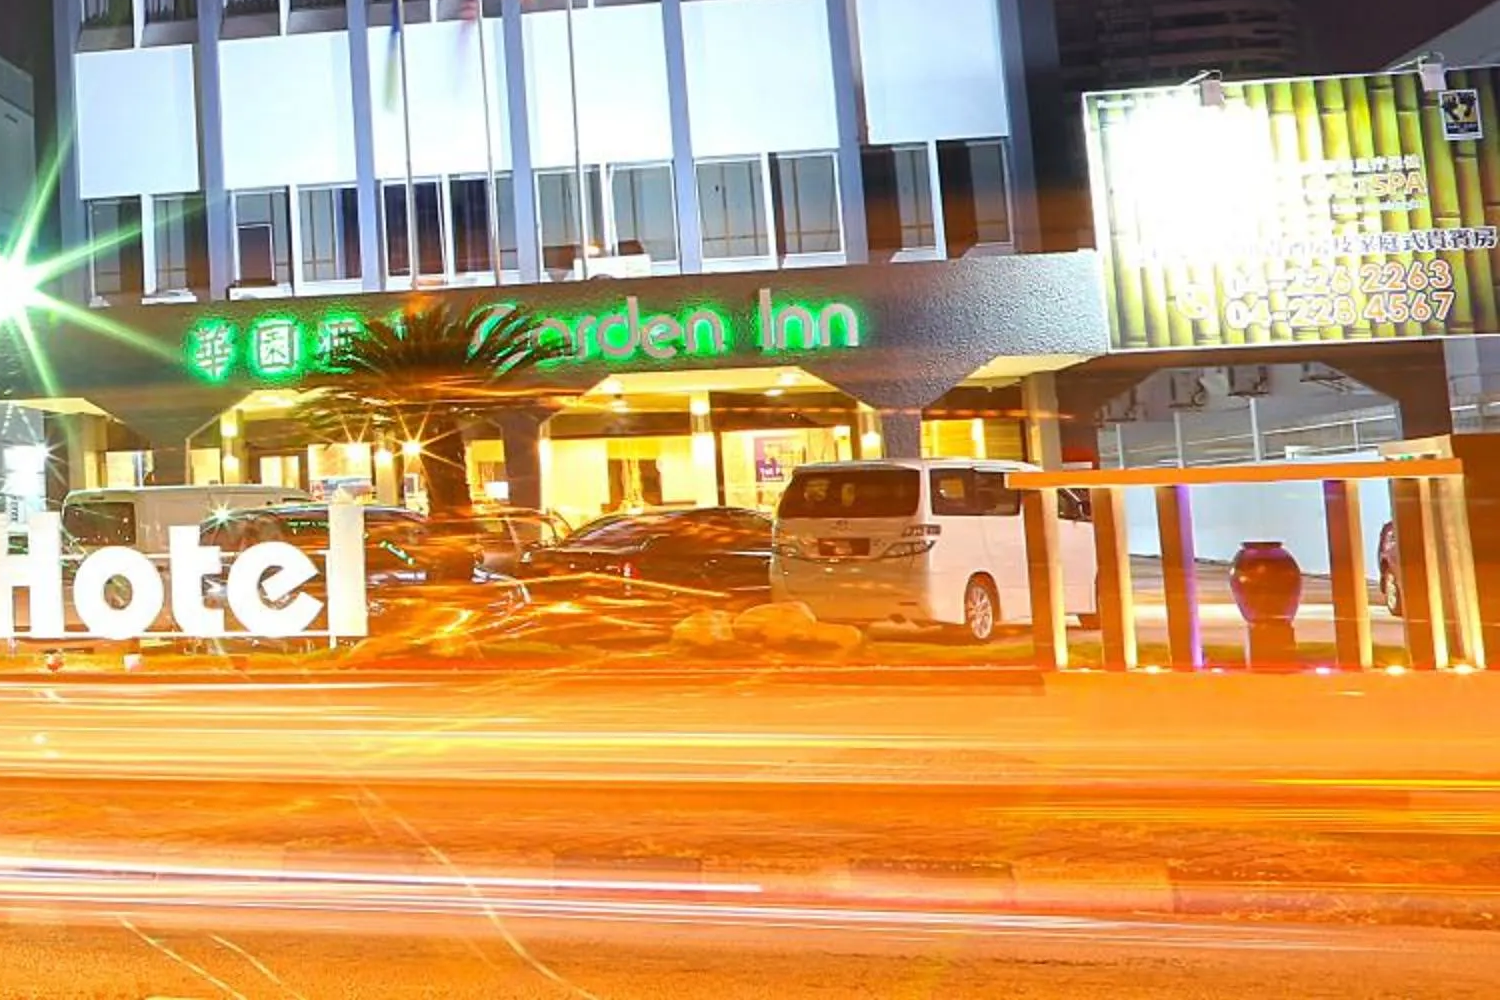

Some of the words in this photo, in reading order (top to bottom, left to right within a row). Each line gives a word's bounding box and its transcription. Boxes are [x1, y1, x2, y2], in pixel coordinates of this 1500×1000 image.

[1360, 259, 1453, 295] 2263
[758, 287, 859, 351] Inn
[1362, 290, 1456, 323] 4567
